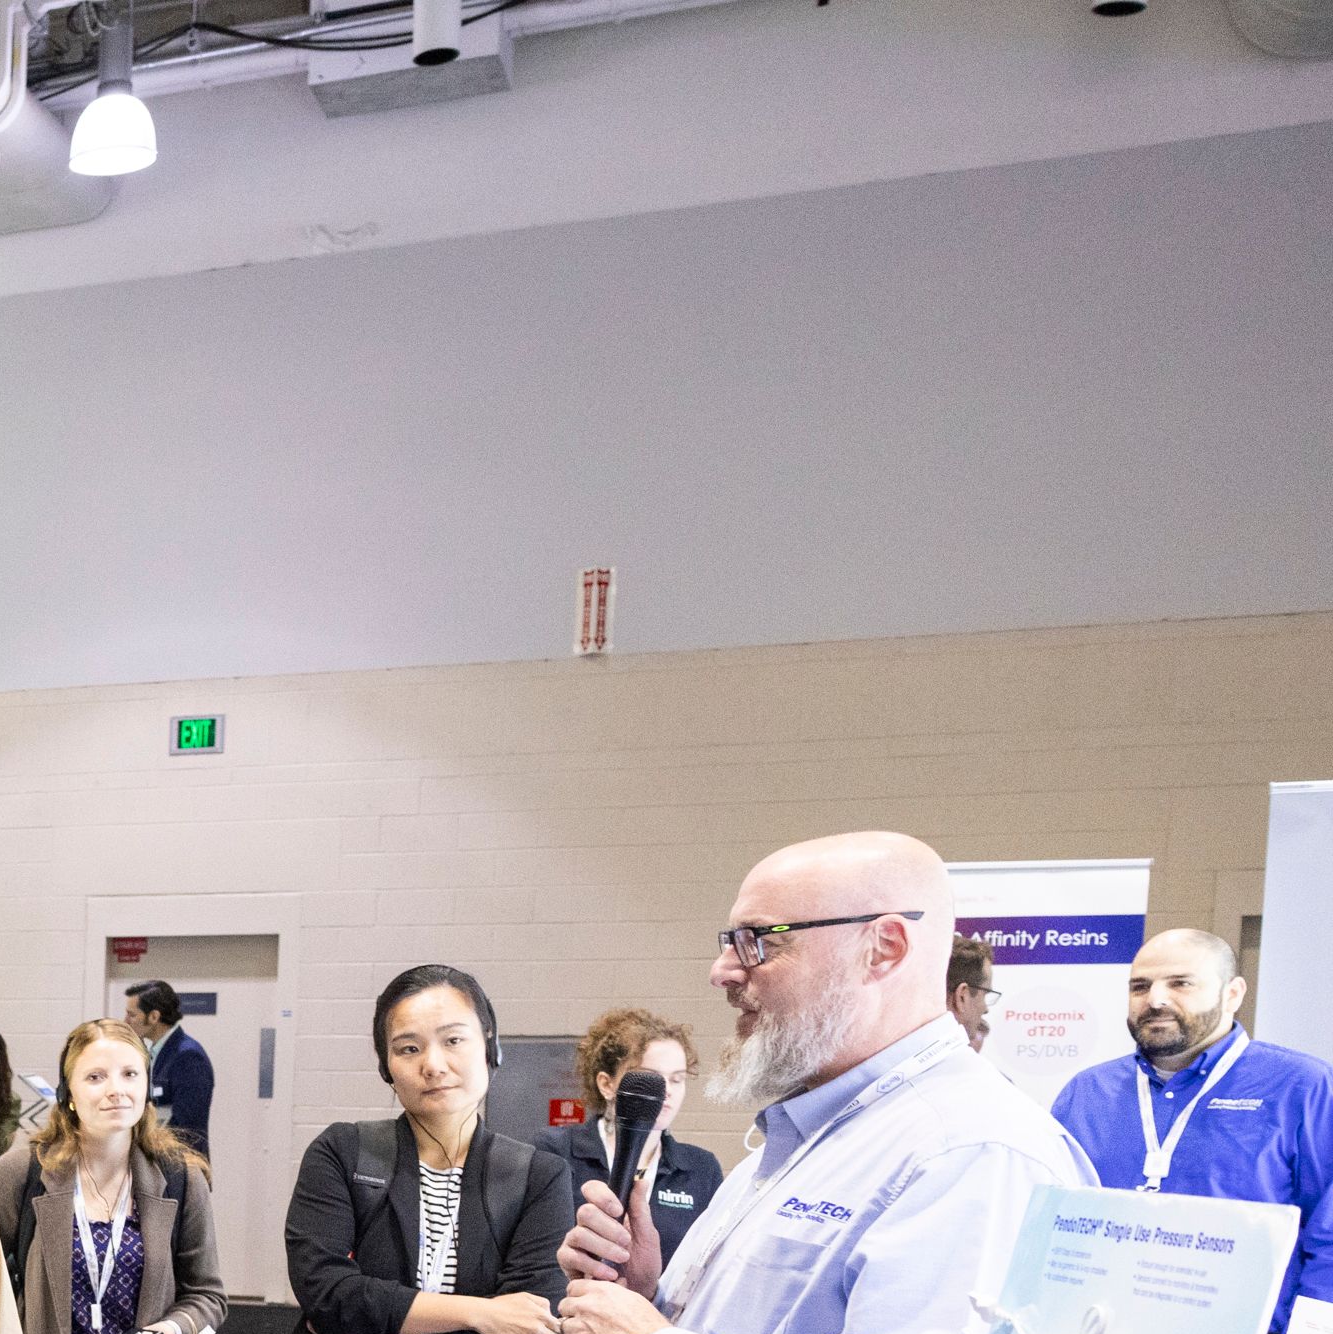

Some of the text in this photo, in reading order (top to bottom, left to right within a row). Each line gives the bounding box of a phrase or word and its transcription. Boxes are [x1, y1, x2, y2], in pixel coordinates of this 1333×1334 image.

[1045, 928, 1109, 947] Resins
[1005, 1010, 1085, 1022] Proteomix
[1027, 1025, 1066, 1037] dT20
[783, 1197, 854, 1222] PENTECH
[1104, 1221, 1132, 1243] Single
[1134, 1224, 1152, 1242] Use
[1153, 1227, 1194, 1248] Pressure
[1195, 1232, 1235, 1254] Sensors
